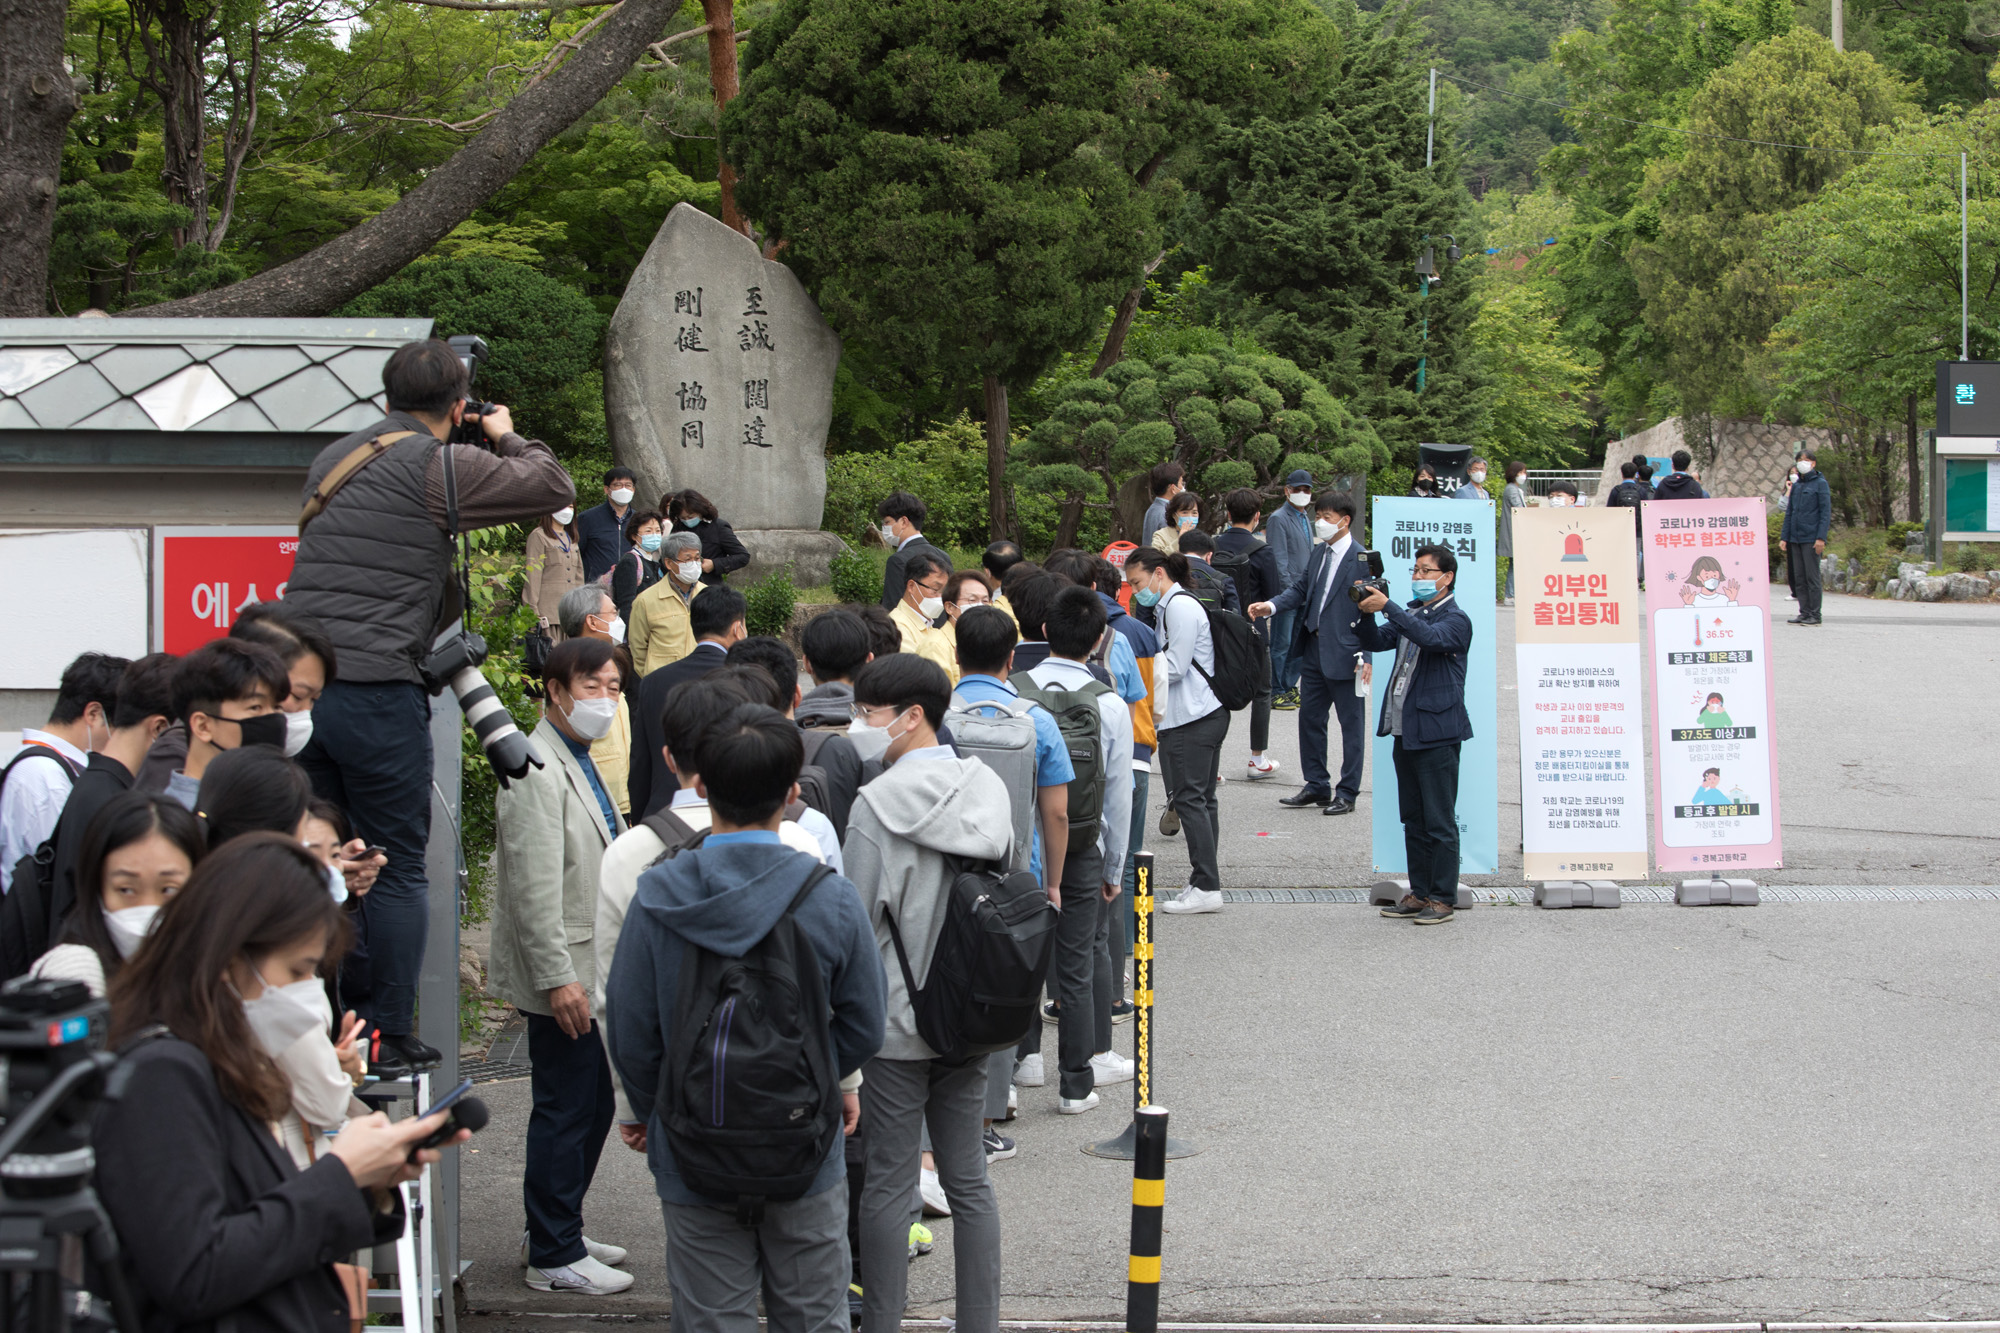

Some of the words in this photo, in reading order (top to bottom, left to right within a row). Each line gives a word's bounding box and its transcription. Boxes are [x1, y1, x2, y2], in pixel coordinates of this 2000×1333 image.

[674, 287, 709, 352] 剛健
[737, 287, 775, 352] 至誠
[1955, 384, 1976, 404] 환
[675, 381, 708, 449] 協同
[1396, 520, 1439, 532] 코로나19
[1442, 522, 1473, 534] 감염증
[1660, 518, 1704, 529] 코로나19
[1708, 516, 1749, 528] 감염예방
[1655, 533, 1696, 548] 학부모
[1700, 531, 1756, 547] 협조사항
[1544, 574, 1608, 597] 외부인
[1534, 602, 1620, 625] 출입통제
[1674, 653, 1693, 664] 등교
[1696, 652, 1705, 663] 전
[1709, 651, 1747, 662] 체온측정
[1542, 668, 1575, 676] 코로나19
[1577, 668, 1614, 676] 바이러스의
[1538, 680, 1553, 688] 교내
[1556, 680, 1570, 688] 확산
[1573, 680, 1594, 688] 방지를
[1598, 680, 1620, 688] 위하여
[1535, 703, 1558, 711] 학생과
[1560, 703, 1575, 711] 교사
[1577, 703, 1592, 711] 이외
[1595, 703, 1624, 711] 방문객의
[1560, 715, 1575, 723] 교내
[1578, 715, 1600, 723] 출입을
[1536, 726, 1558, 735] 엄격히
[1561, 726, 1591, 735] 금지하고
[1593, 726, 1625, 735] 있습니다.
[1680, 729, 1712, 740] 37.5도
[1715, 728, 1735, 739] 이상
[1737, 728, 1747, 738] 시
[1542, 750, 1556, 758] 급한
[1560, 750, 1582, 758] 용무가
[1584, 750, 1622, 758] 있으신분은
[1535, 762, 1549, 770] 정문
[1552, 762, 1612, 770] 배움터지킴이실을
[1614, 762, 1629, 770] 통해
[1538, 773, 1560, 782] 안내를
[1562, 773, 1592, 782] 받으시길
[1595, 773, 1627, 782] 바랍니다.
[1542, 797, 1557, 805] 저희
[1560, 797, 1582, 805] 학교는
[1585, 797, 1624, 805] 코로나19의
[1548, 808, 1562, 817] 교내
[1565, 808, 1602, 817] 감염예방을
[1605, 808, 1620, 817] 위해
[1684, 806, 1703, 817] 등교
[1706, 806, 1716, 816] 후
[1718, 805, 1738, 816] 발열
[1741, 805, 1750, 815] 시
[1548, 820, 1570, 829] 최선을
[1573, 820, 1620, 829] 다하겠습니다.
[1702, 853, 1747, 862] 경복고등학교
[1570, 863, 1614, 872] 경복고등학교
